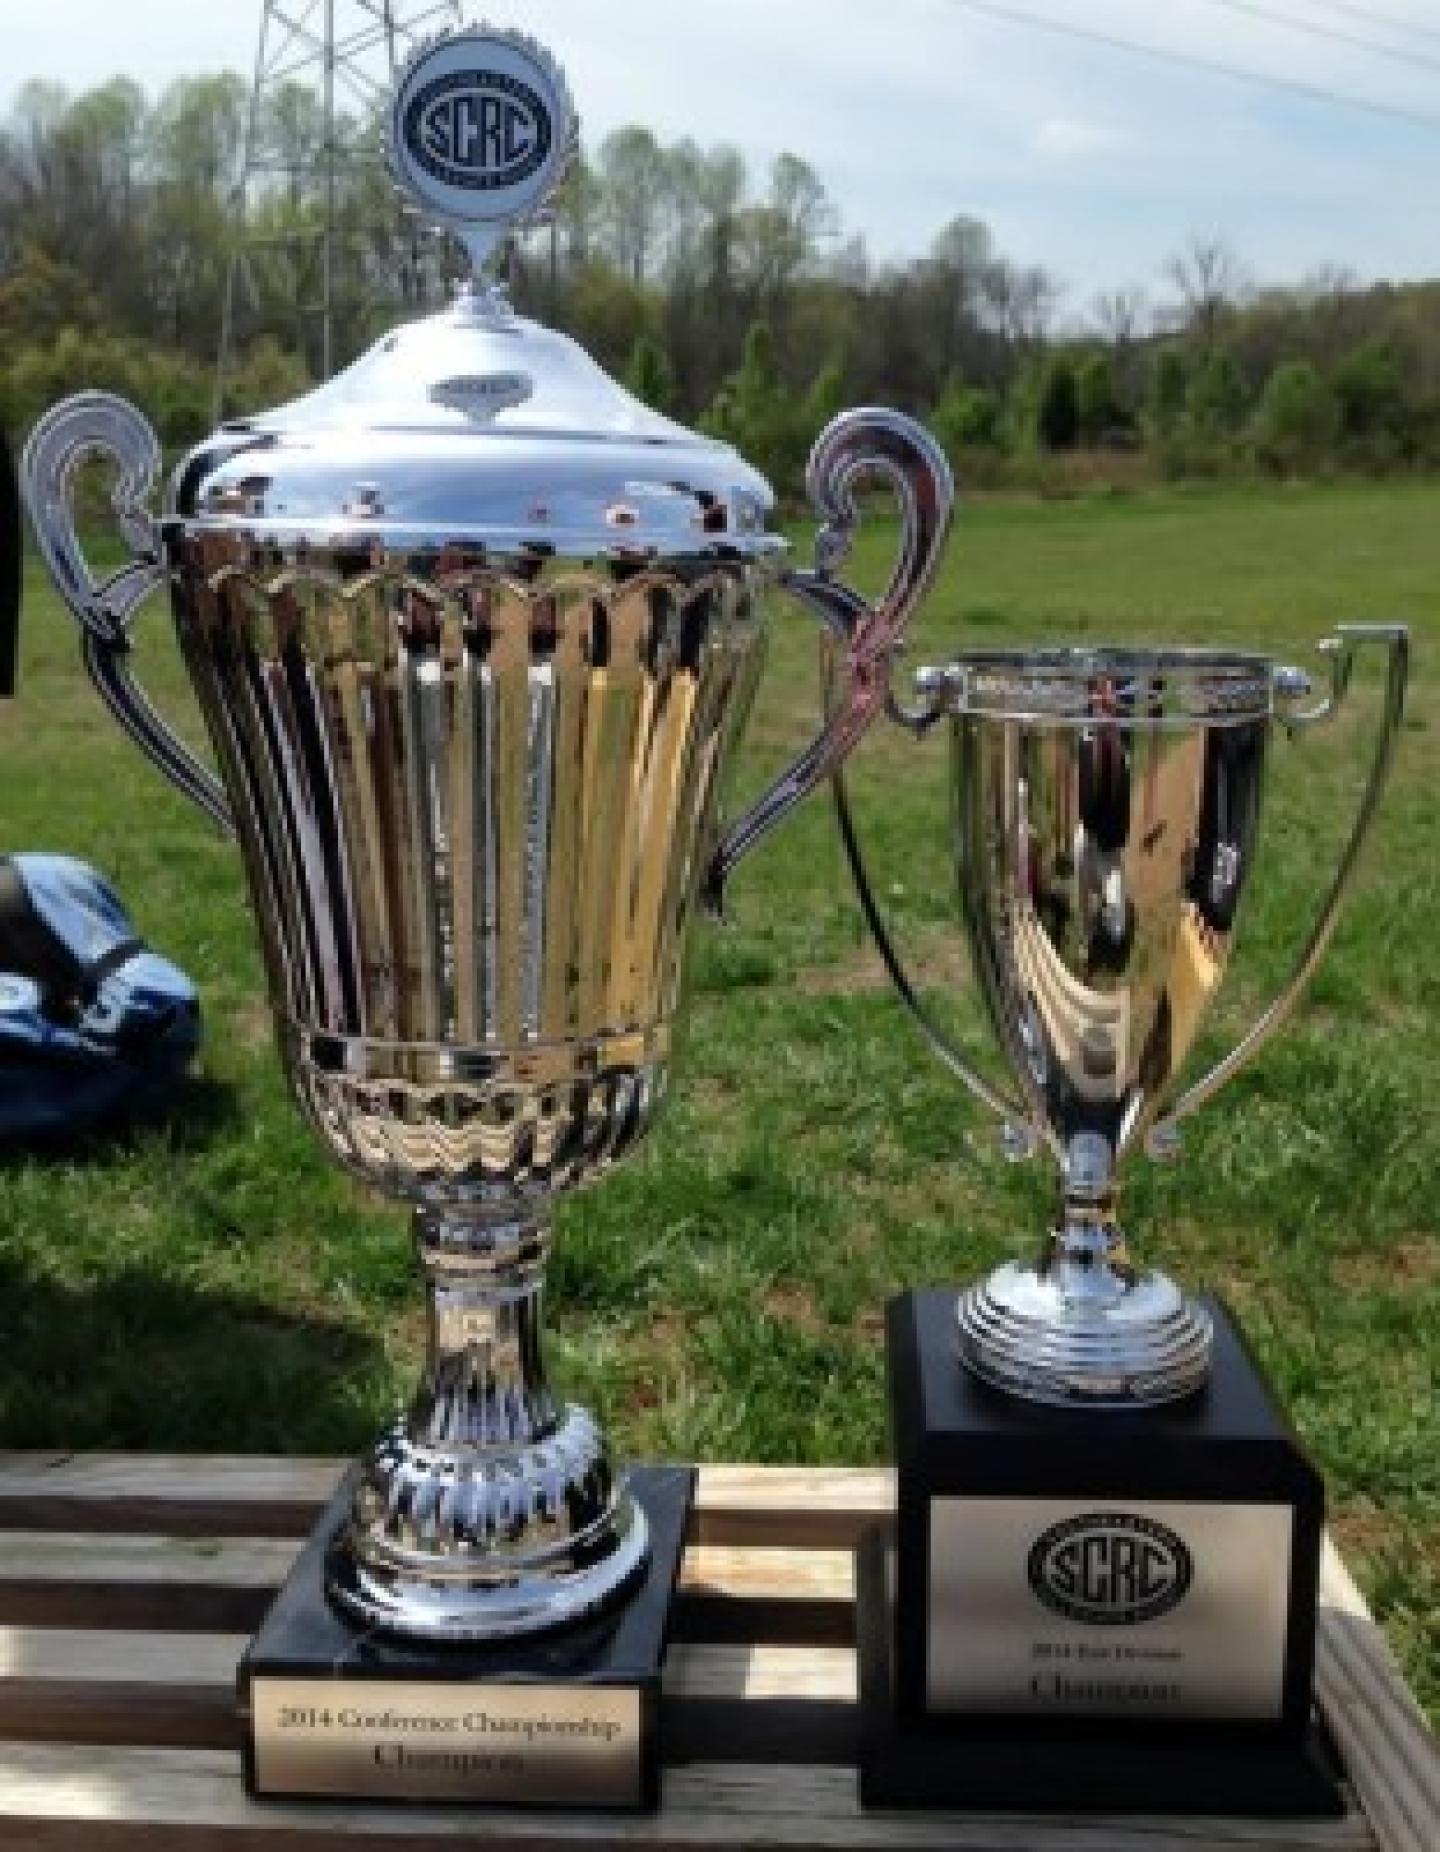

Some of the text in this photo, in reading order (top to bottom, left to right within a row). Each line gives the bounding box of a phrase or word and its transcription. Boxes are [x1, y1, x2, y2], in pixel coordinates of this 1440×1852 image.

[425, 95, 530, 169] SCRC
[1051, 1536, 1169, 1604] SCRC
[277, 1705, 622, 1741] 2014 Conference Championship
[373, 1743, 525, 1776] Champion
